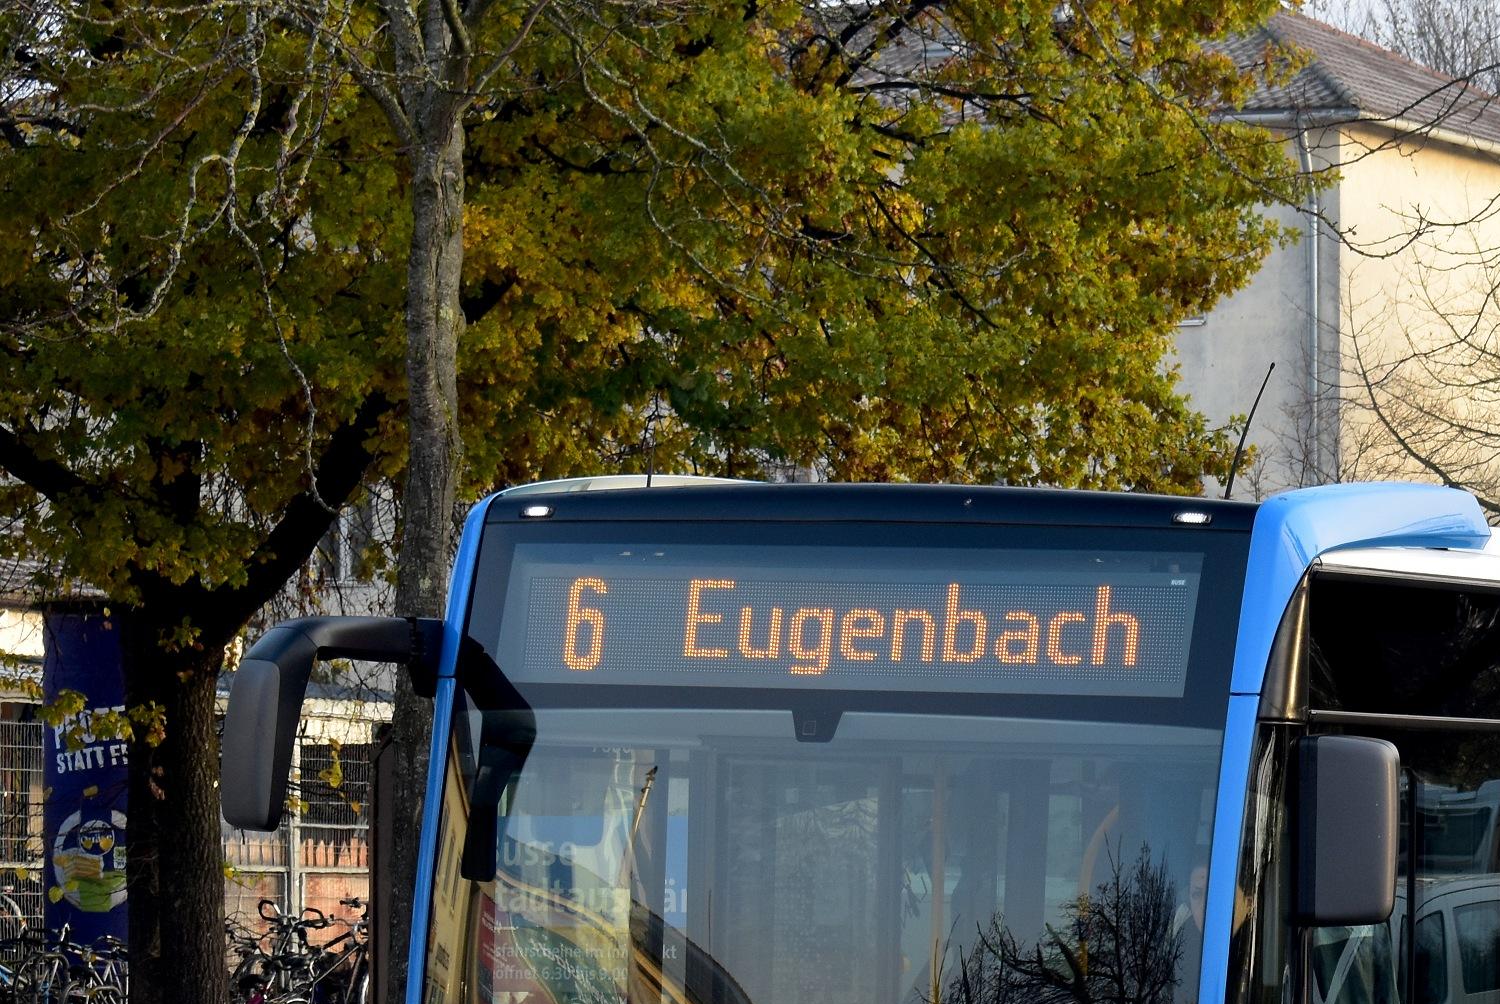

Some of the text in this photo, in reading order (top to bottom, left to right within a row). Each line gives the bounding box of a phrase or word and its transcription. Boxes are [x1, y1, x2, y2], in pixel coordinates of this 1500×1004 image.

[562, 576, 1141, 676] 6 Eugenbach
[56, 746, 105, 774] STATT
